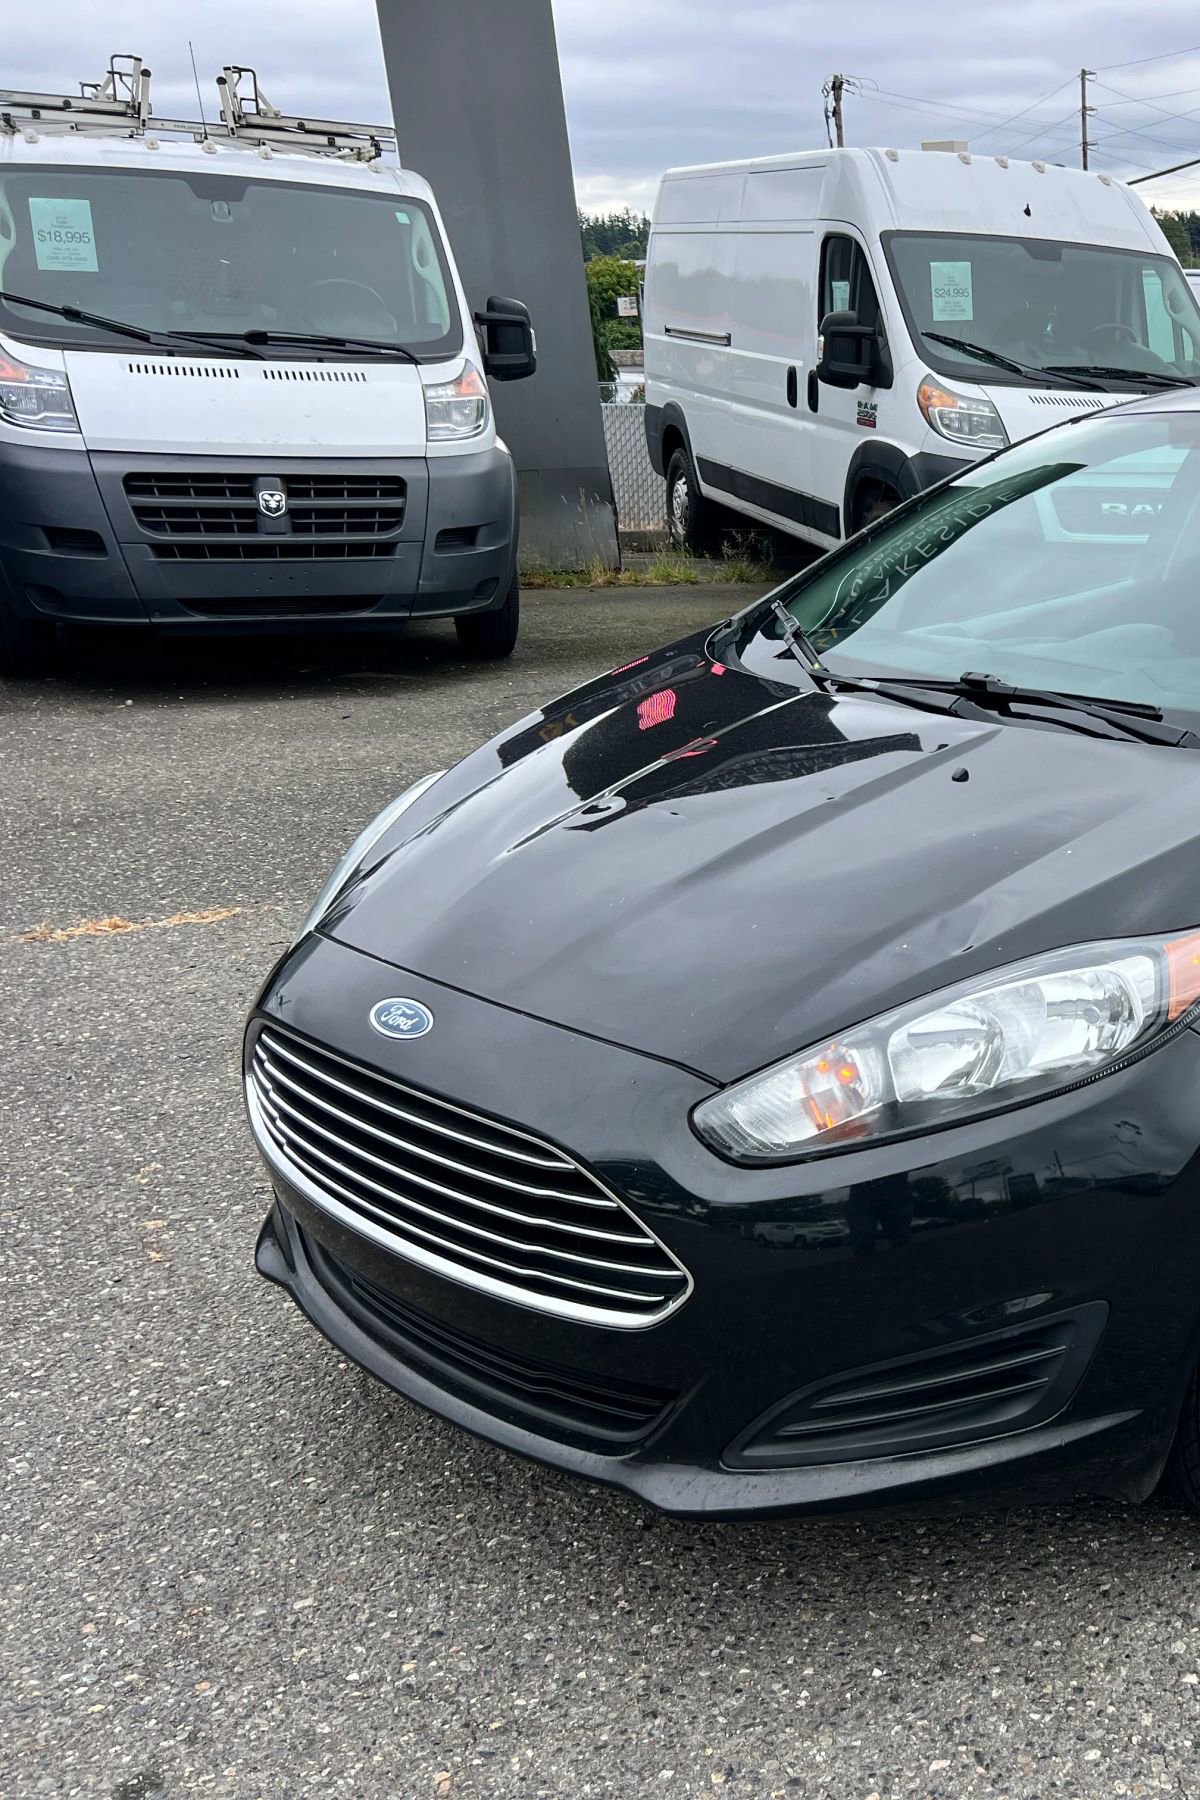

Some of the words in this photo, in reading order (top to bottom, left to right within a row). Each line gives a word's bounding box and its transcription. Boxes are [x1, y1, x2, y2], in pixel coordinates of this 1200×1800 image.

[37, 229, 91, 245] $18,995
[934, 287, 970, 299] $24,995
[1101, 502, 1163, 516] RA
[380, 1004, 420, 1031] Ford
